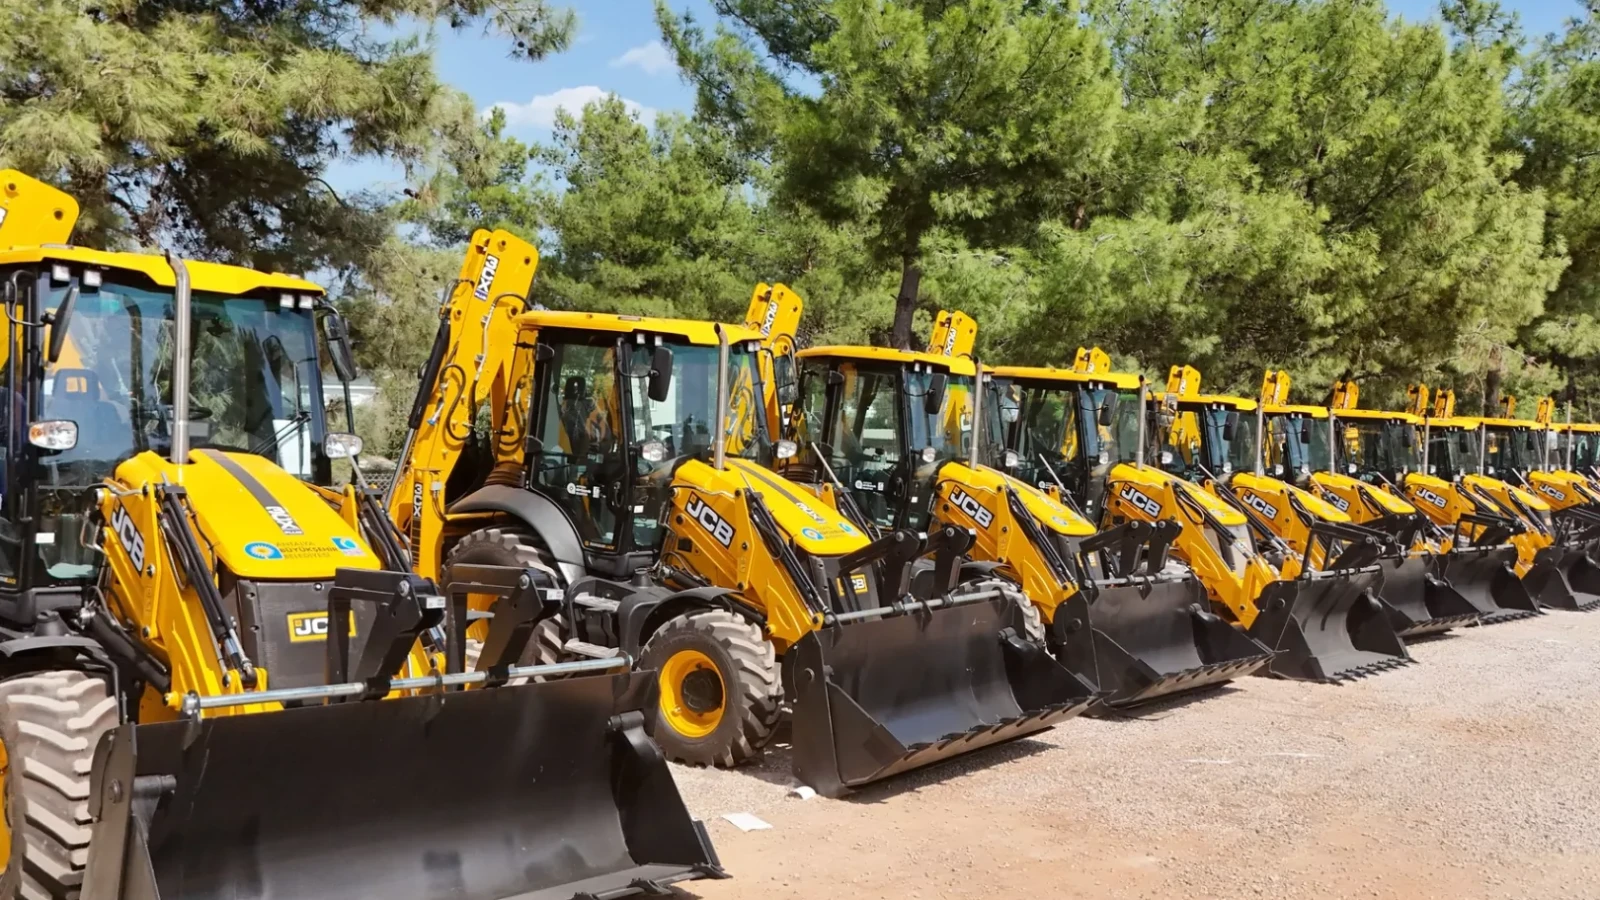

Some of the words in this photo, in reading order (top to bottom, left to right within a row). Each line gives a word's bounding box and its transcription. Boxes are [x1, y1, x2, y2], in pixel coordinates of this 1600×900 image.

[412, 483, 423, 518] 3CX
[1121, 488, 1161, 517] JCB
[1325, 491, 1349, 511] CB
[1416, 488, 1446, 508] JCB
[1539, 484, 1566, 501] JCB
[950, 491, 993, 528] JCB
[1242, 494, 1278, 520] JCB
[686, 500, 734, 546] JCB
[112, 506, 145, 572] JCB
[295, 617, 329, 636] JC
